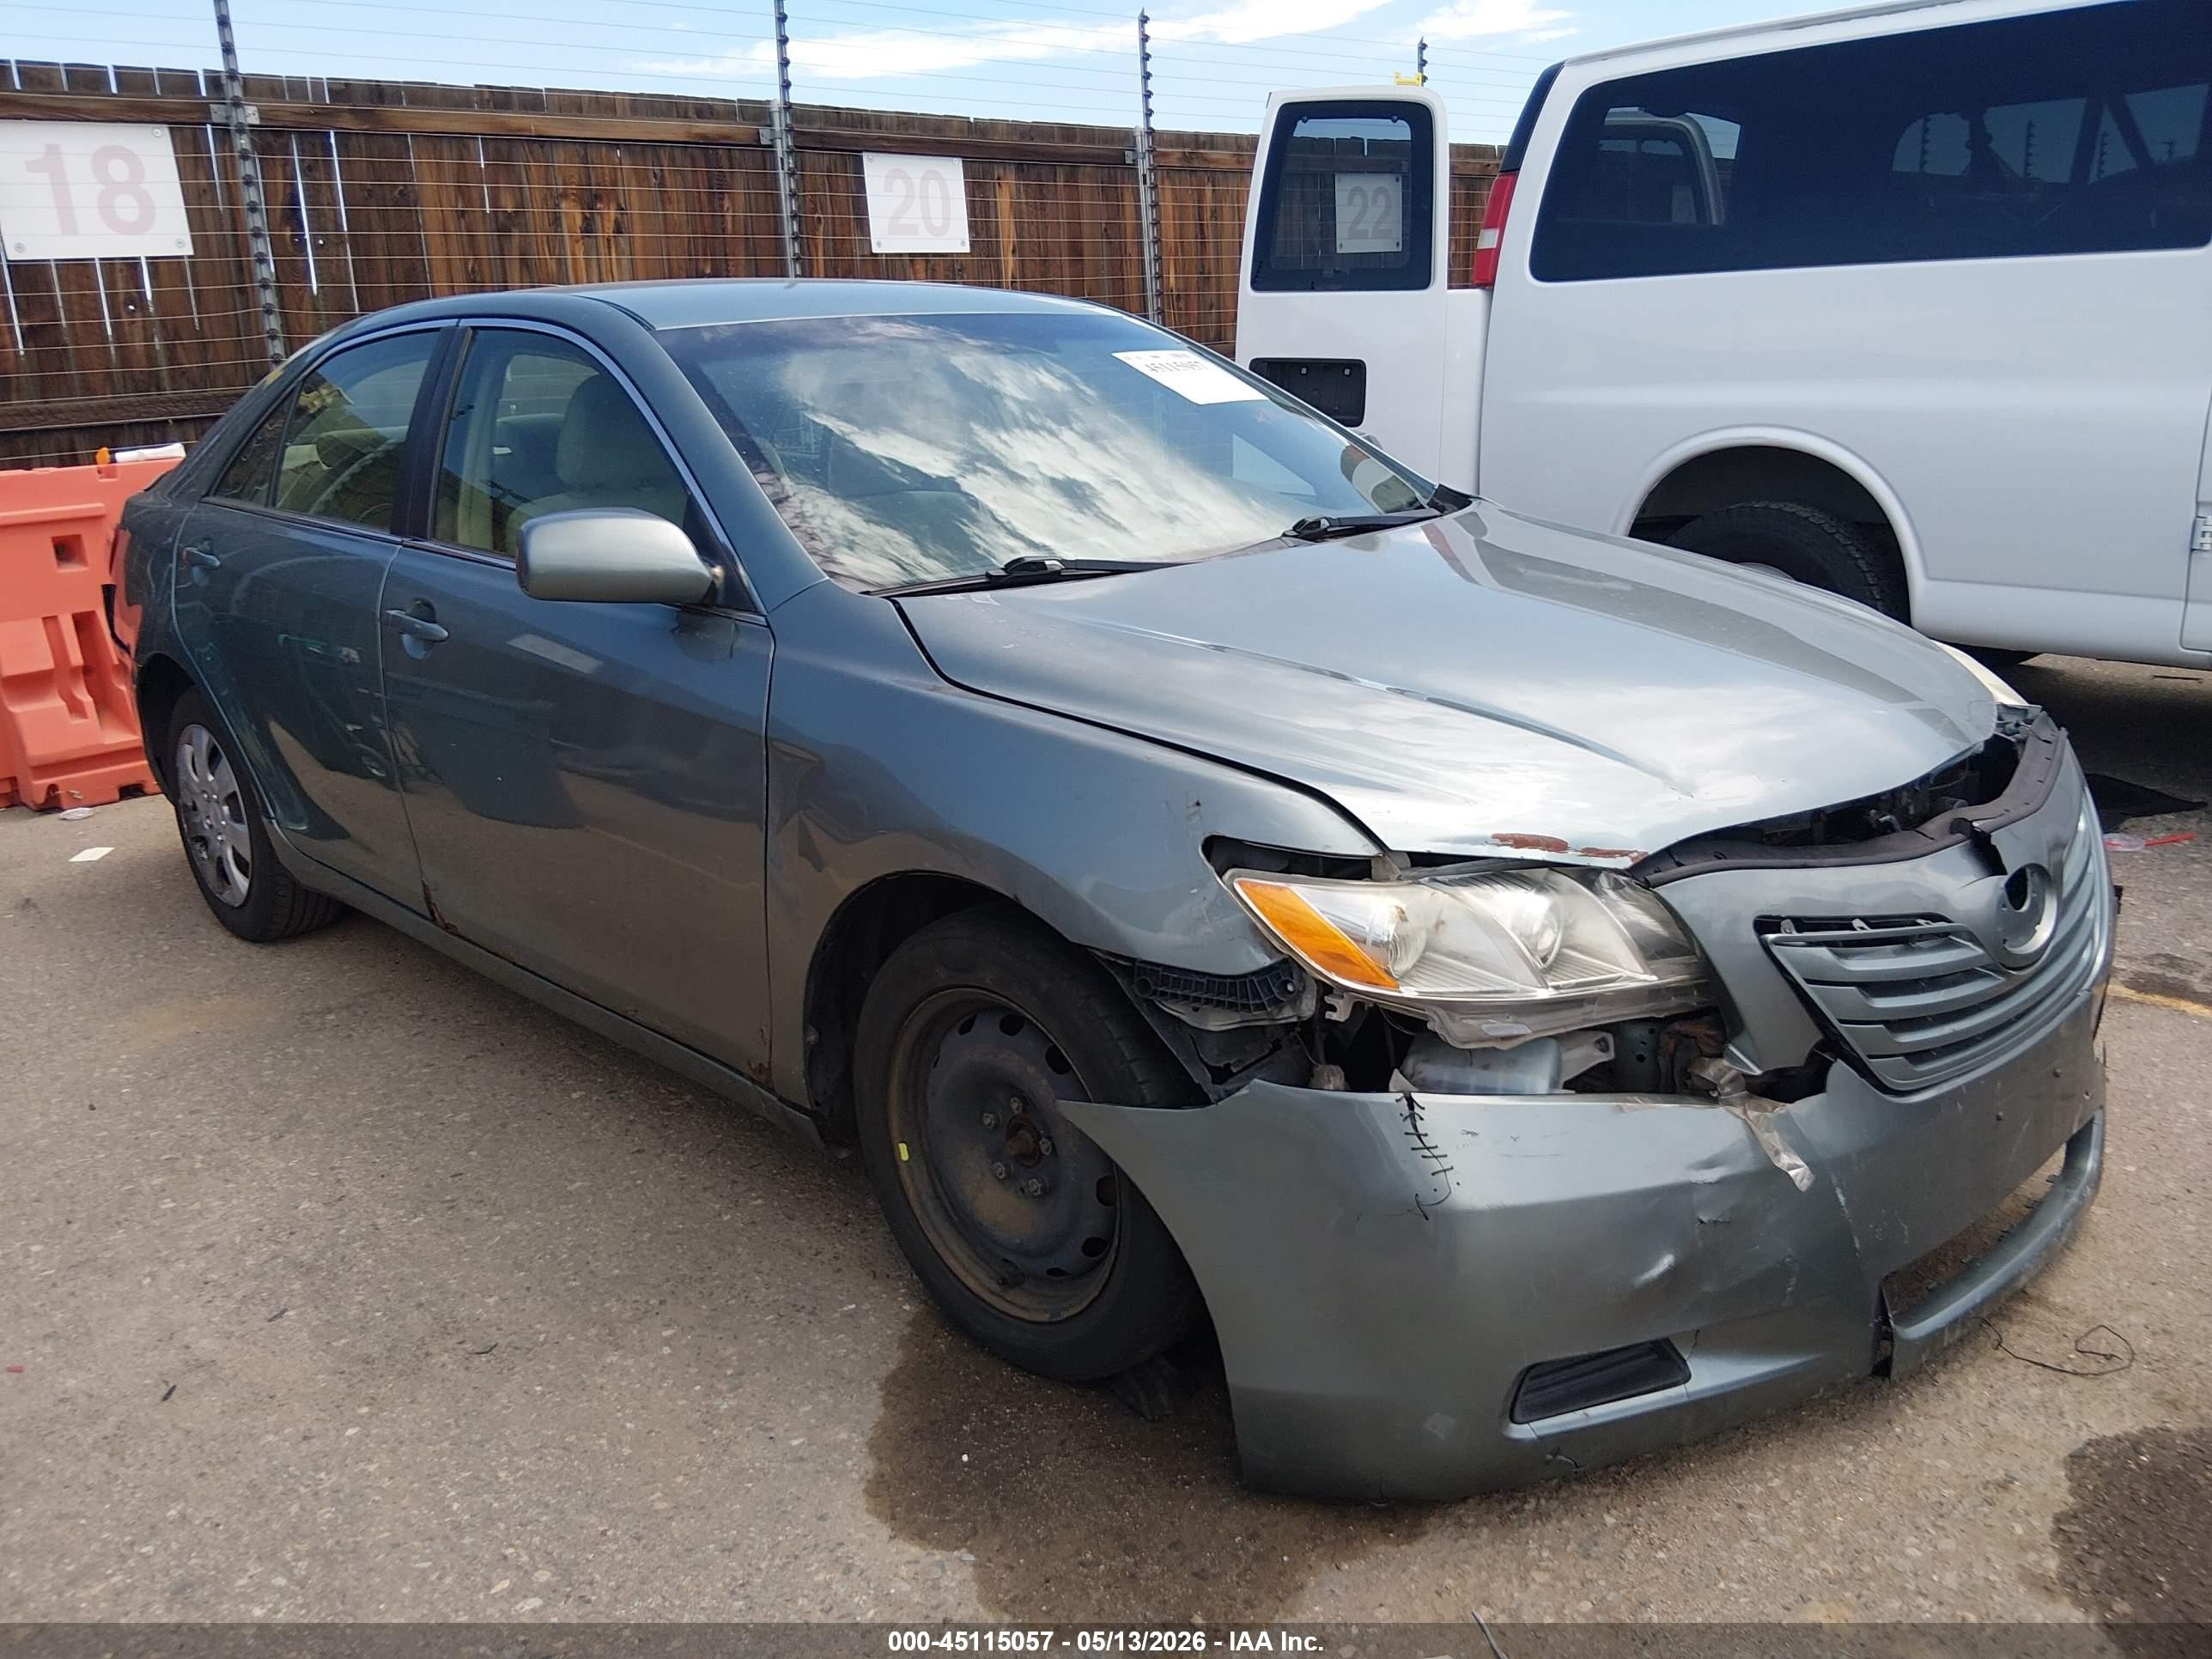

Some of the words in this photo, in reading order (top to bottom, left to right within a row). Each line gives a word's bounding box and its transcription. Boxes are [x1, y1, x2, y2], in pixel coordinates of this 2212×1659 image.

[24, 143, 156, 235] 18
[884, 167, 951, 237] 20
[1346, 185, 1393, 240] 22
